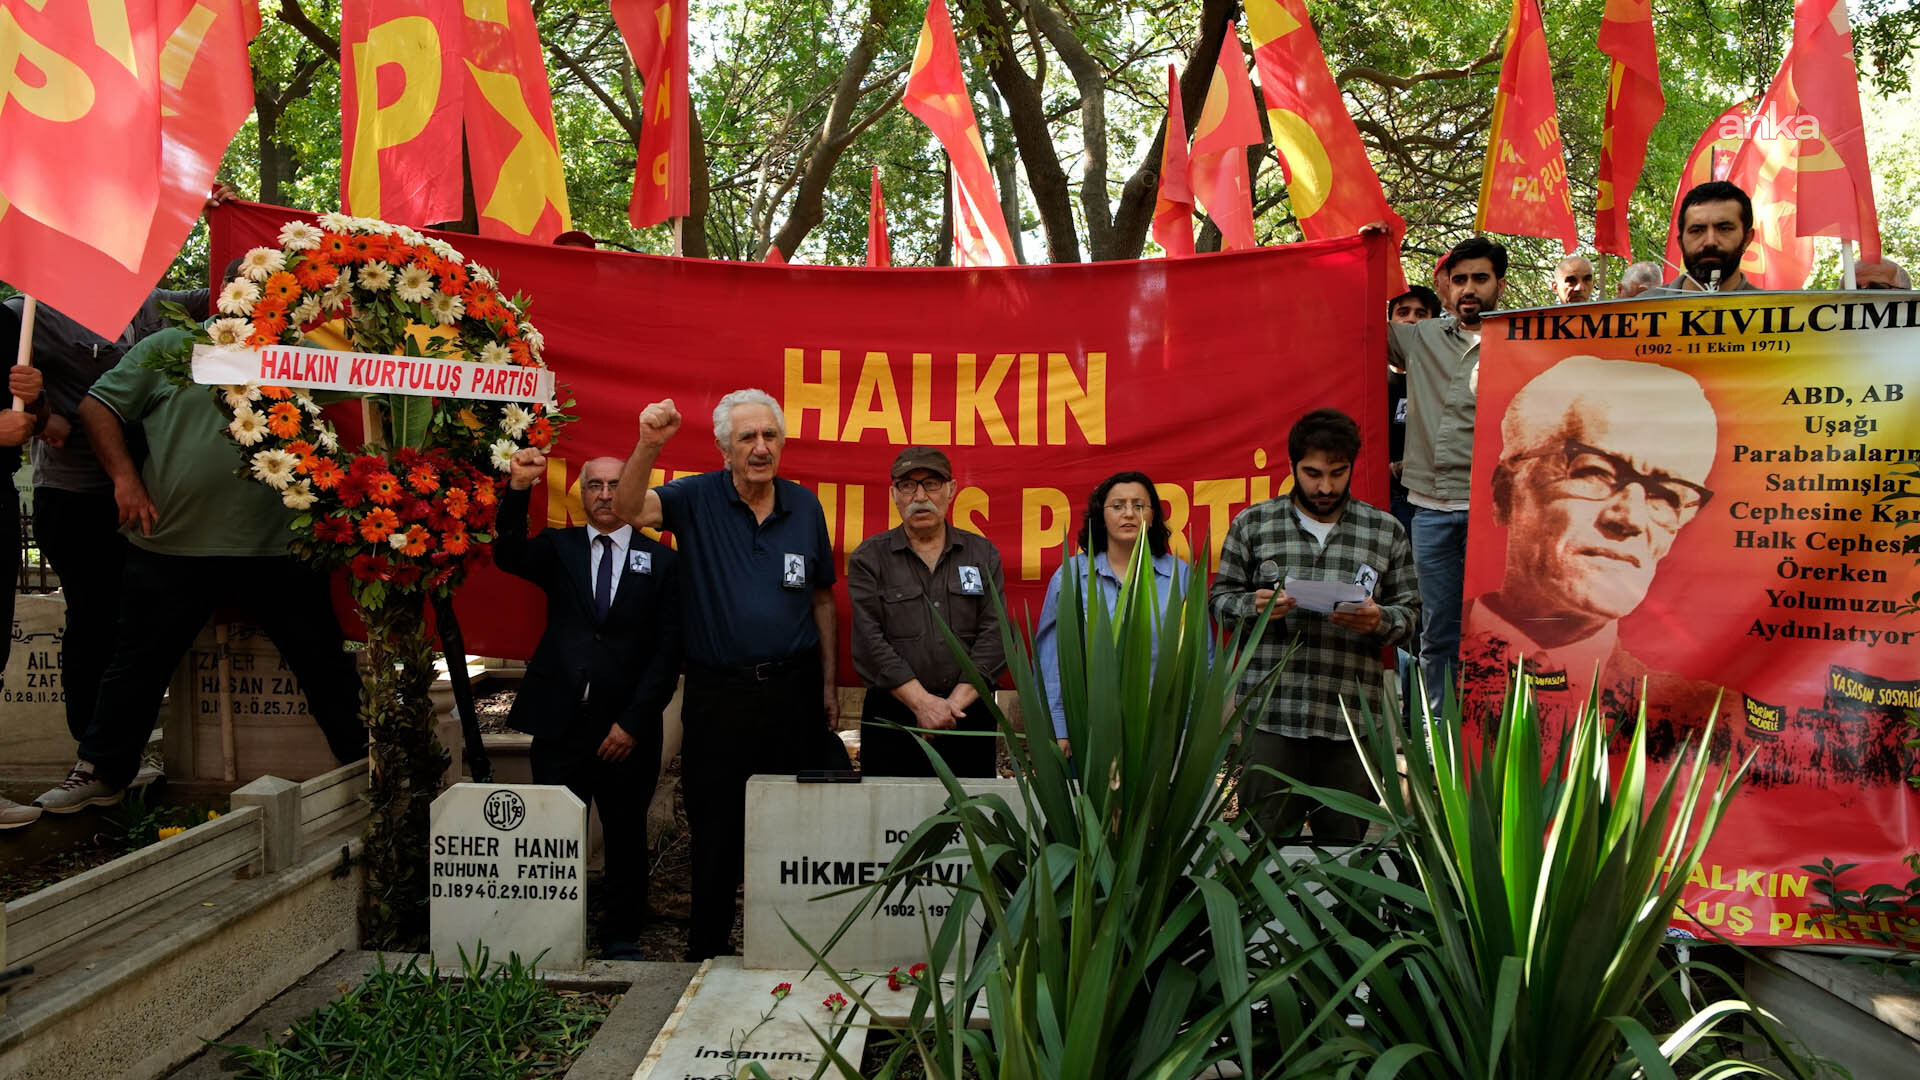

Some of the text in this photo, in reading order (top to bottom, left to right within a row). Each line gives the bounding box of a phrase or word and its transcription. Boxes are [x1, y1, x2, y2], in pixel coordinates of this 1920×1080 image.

[1505, 312, 1667, 340] HİKMET
[1635, 343, 1672, 357] (1902
[1688, 343, 1701, 353] 11
[1707, 342, 1745, 353] Ekim
[1752, 340, 1791, 353] 1971)
[260, 349, 539, 397] HALKIN KURTULUŞ PARTİSİ
[784, 347, 1107, 446] HALKIN
[1782, 383, 1904, 407] ABD, AB
[1804, 414, 1879, 437] Uşağı
[1766, 473, 1912, 496] Satılmışlar
[1730, 502, 1862, 524] Cephesine
[1734, 530, 1796, 549] Halk
[1777, 556, 1888, 583] Örerken
[1765, 589, 1898, 614] Yolumuzu
[1746, 618, 1915, 647] Aydınlatıyor
[434, 835, 579, 859] SEHER HANIM
[433, 861, 577, 880] RUHUNA FATİHA
[884, 904, 915, 917] 1902
